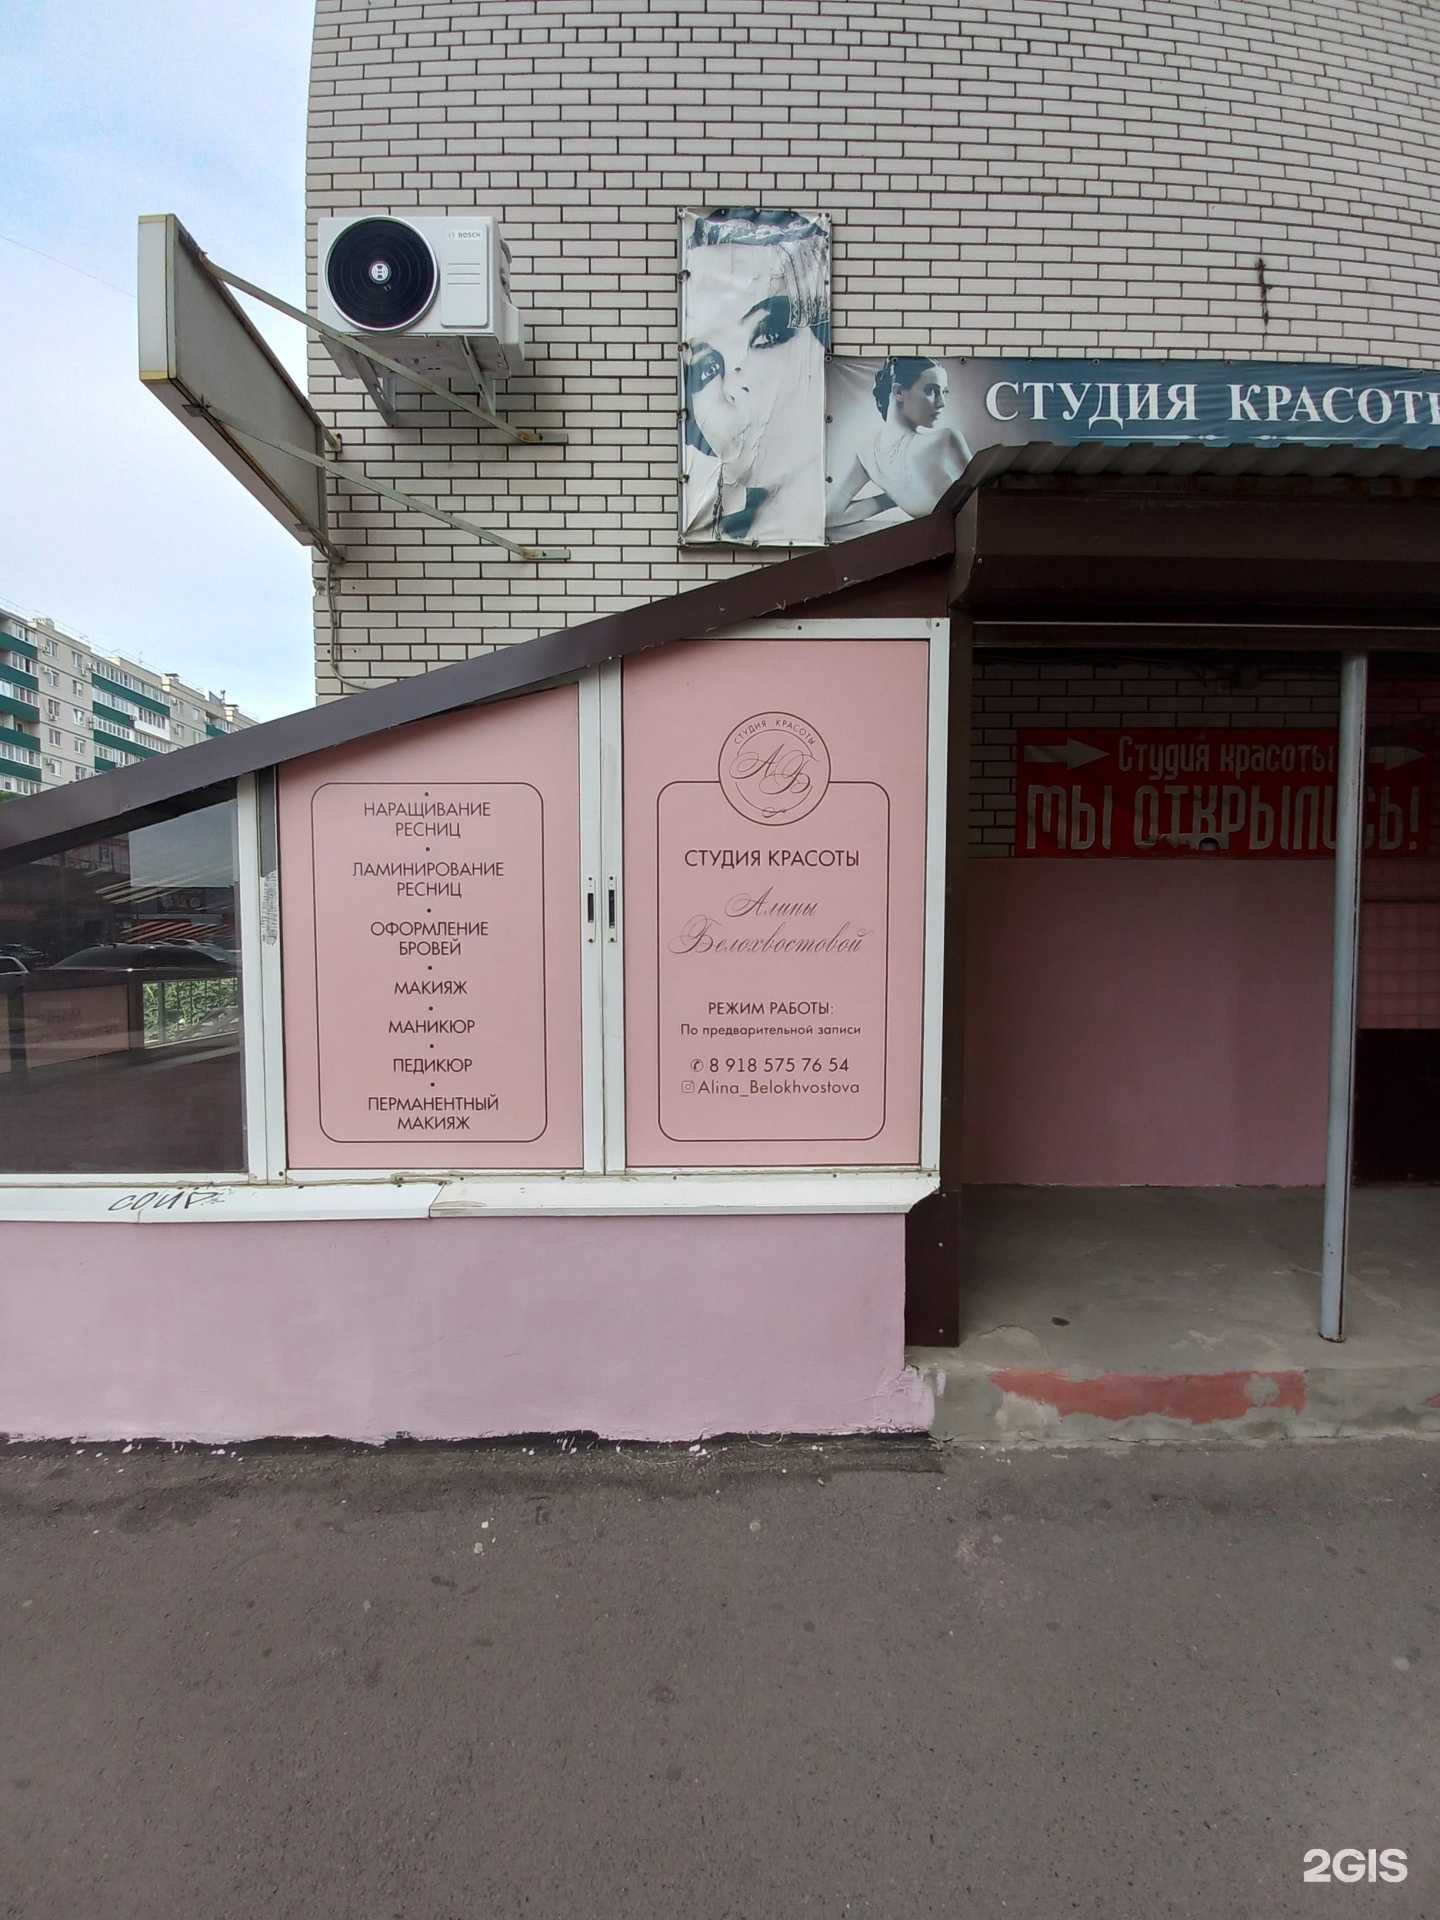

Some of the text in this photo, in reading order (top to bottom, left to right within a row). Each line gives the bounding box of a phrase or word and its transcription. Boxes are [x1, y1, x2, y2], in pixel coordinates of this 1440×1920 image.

[985, 381, 1198, 430] СТУДИЯ
[734, 719, 816, 745] СТУДИЯ КРАСОТЫ
[1118, 736, 1335, 781] Студия красоты
[364, 802, 491, 818] НАРАЩИВАНИЕ
[395, 822, 461, 839] РЕСНИЦ
[684, 850, 859, 869] СТУДИЯ КРАСОТЫ
[352, 862, 504, 877] ЛАМИНИРОВАНИЕ
[397, 882, 462, 898] РЕСНИЦ
[724, 885, 819, 918] Алины
[370, 921, 488, 937] ОФОРМЛЕНИЕ
[399, 938, 461, 956] БРОВЕЙ
[394, 980, 468, 995] МАКИЯЖ
[708, 1001, 834, 1015] РЕЖИМ РАБОТЫ:
[388, 1019, 475, 1034] МАНИКЮР
[680, 1023, 862, 1038] По предварительной записи
[393, 1058, 473, 1074] ПЕДИКЮР
[709, 1057, 849, 1073] 8 918 575 76 54
[697, 1079, 860, 1097] Alina_Belokhvostova
[368, 1093, 499, 1111] ПЕРМАНЕНТНЫЙ
[397, 1115, 470, 1130] МАКИЯЖ
